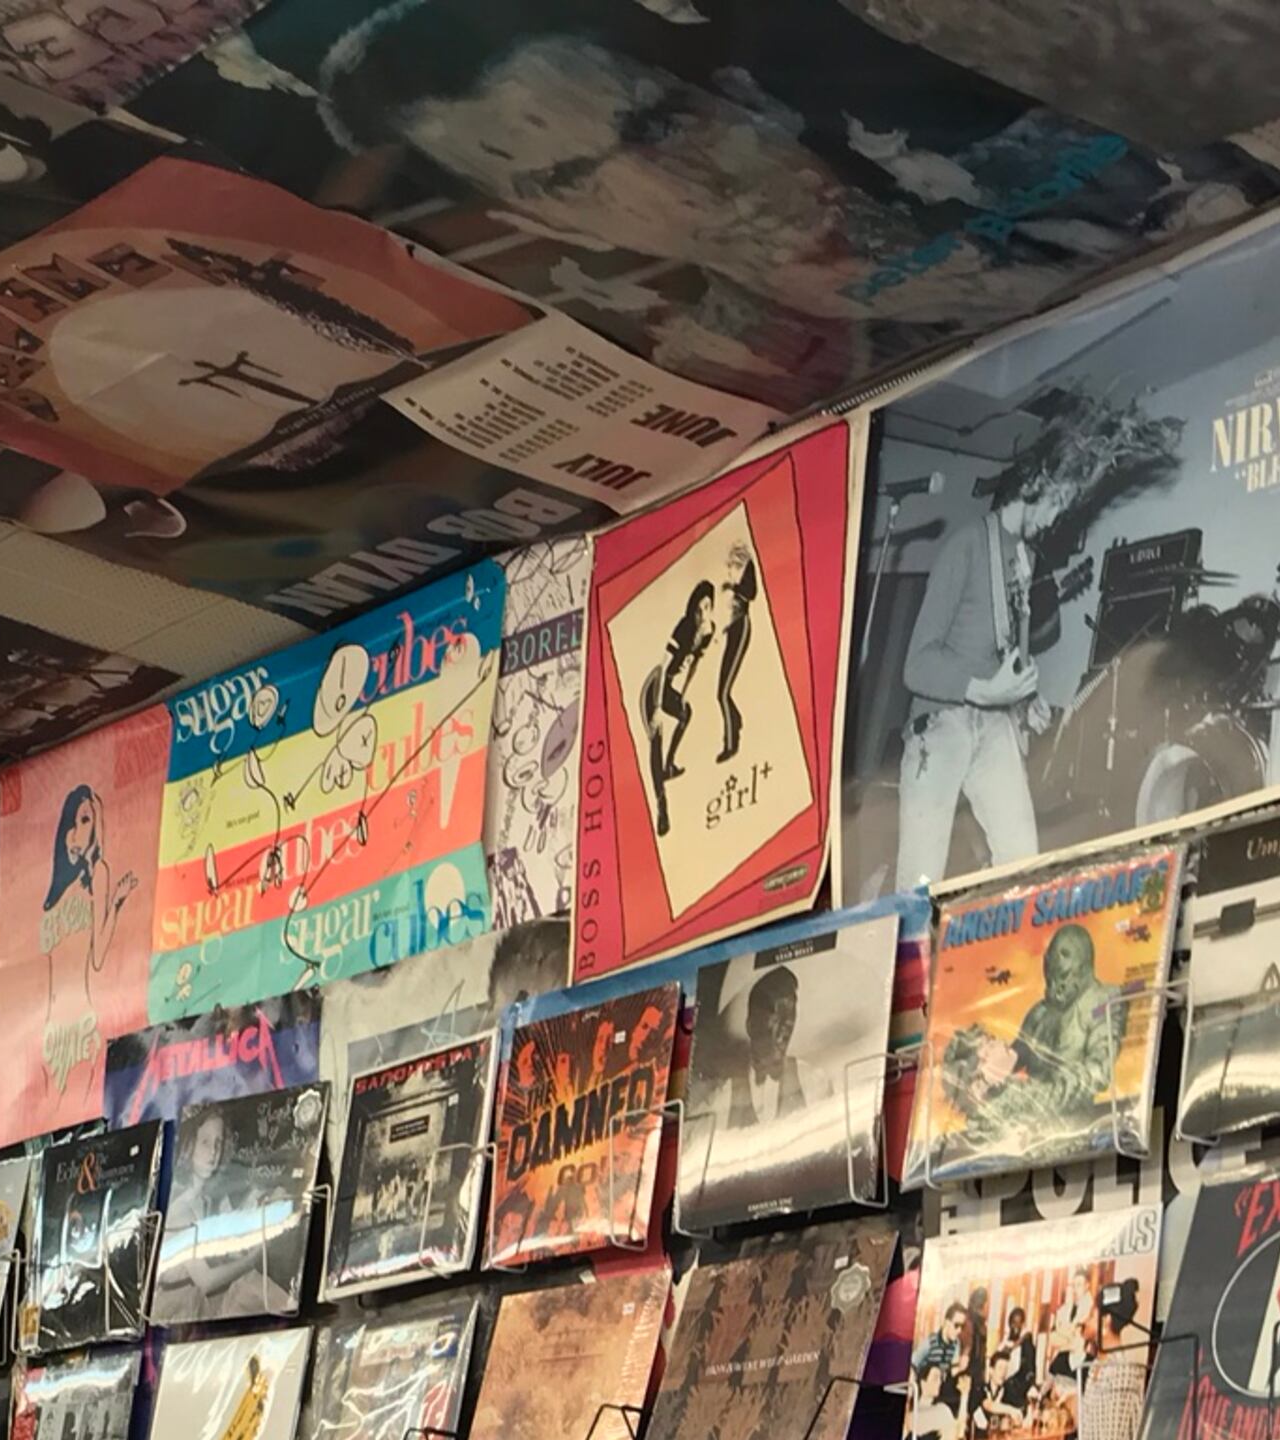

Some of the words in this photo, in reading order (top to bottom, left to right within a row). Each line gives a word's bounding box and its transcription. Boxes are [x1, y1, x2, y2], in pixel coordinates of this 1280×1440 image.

[631, 402, 739, 450] JUNE
[553, 453, 655, 492] JULY
[427, 487, 584, 547] BOB
[586, 739, 607, 831] HOG
[577, 858, 602, 973] BOSS
[942, 905, 1025, 949] ANGRY
